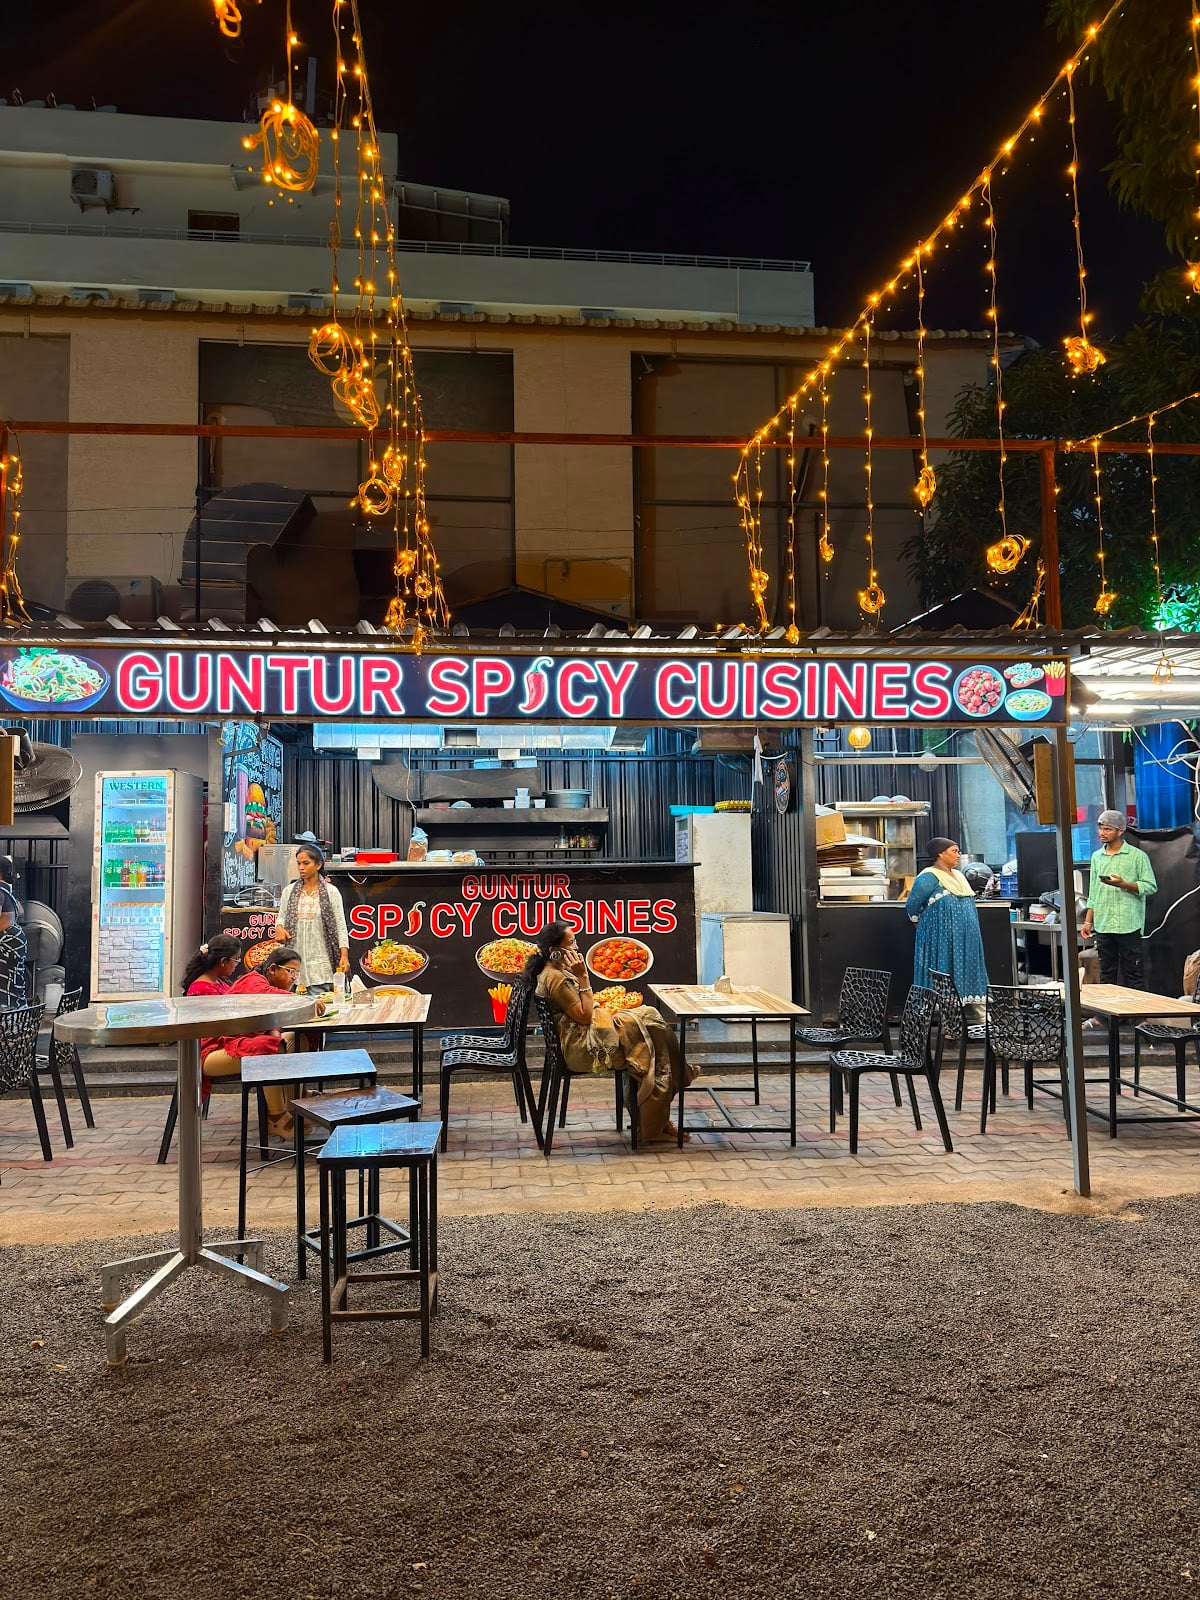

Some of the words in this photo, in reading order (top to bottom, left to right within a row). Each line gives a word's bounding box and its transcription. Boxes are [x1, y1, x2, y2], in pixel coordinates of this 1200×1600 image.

[116, 652, 405, 714] GUNTUR
[425, 656, 638, 716] SPICY
[657, 661, 950, 718] CUISINES
[109, 781, 163, 790] WESTERN
[461, 873, 571, 900] GUNTUR
[249, 913, 278, 926] GUN
[348, 901, 481, 940] SPICY
[492, 899, 677, 936] CUISINES
